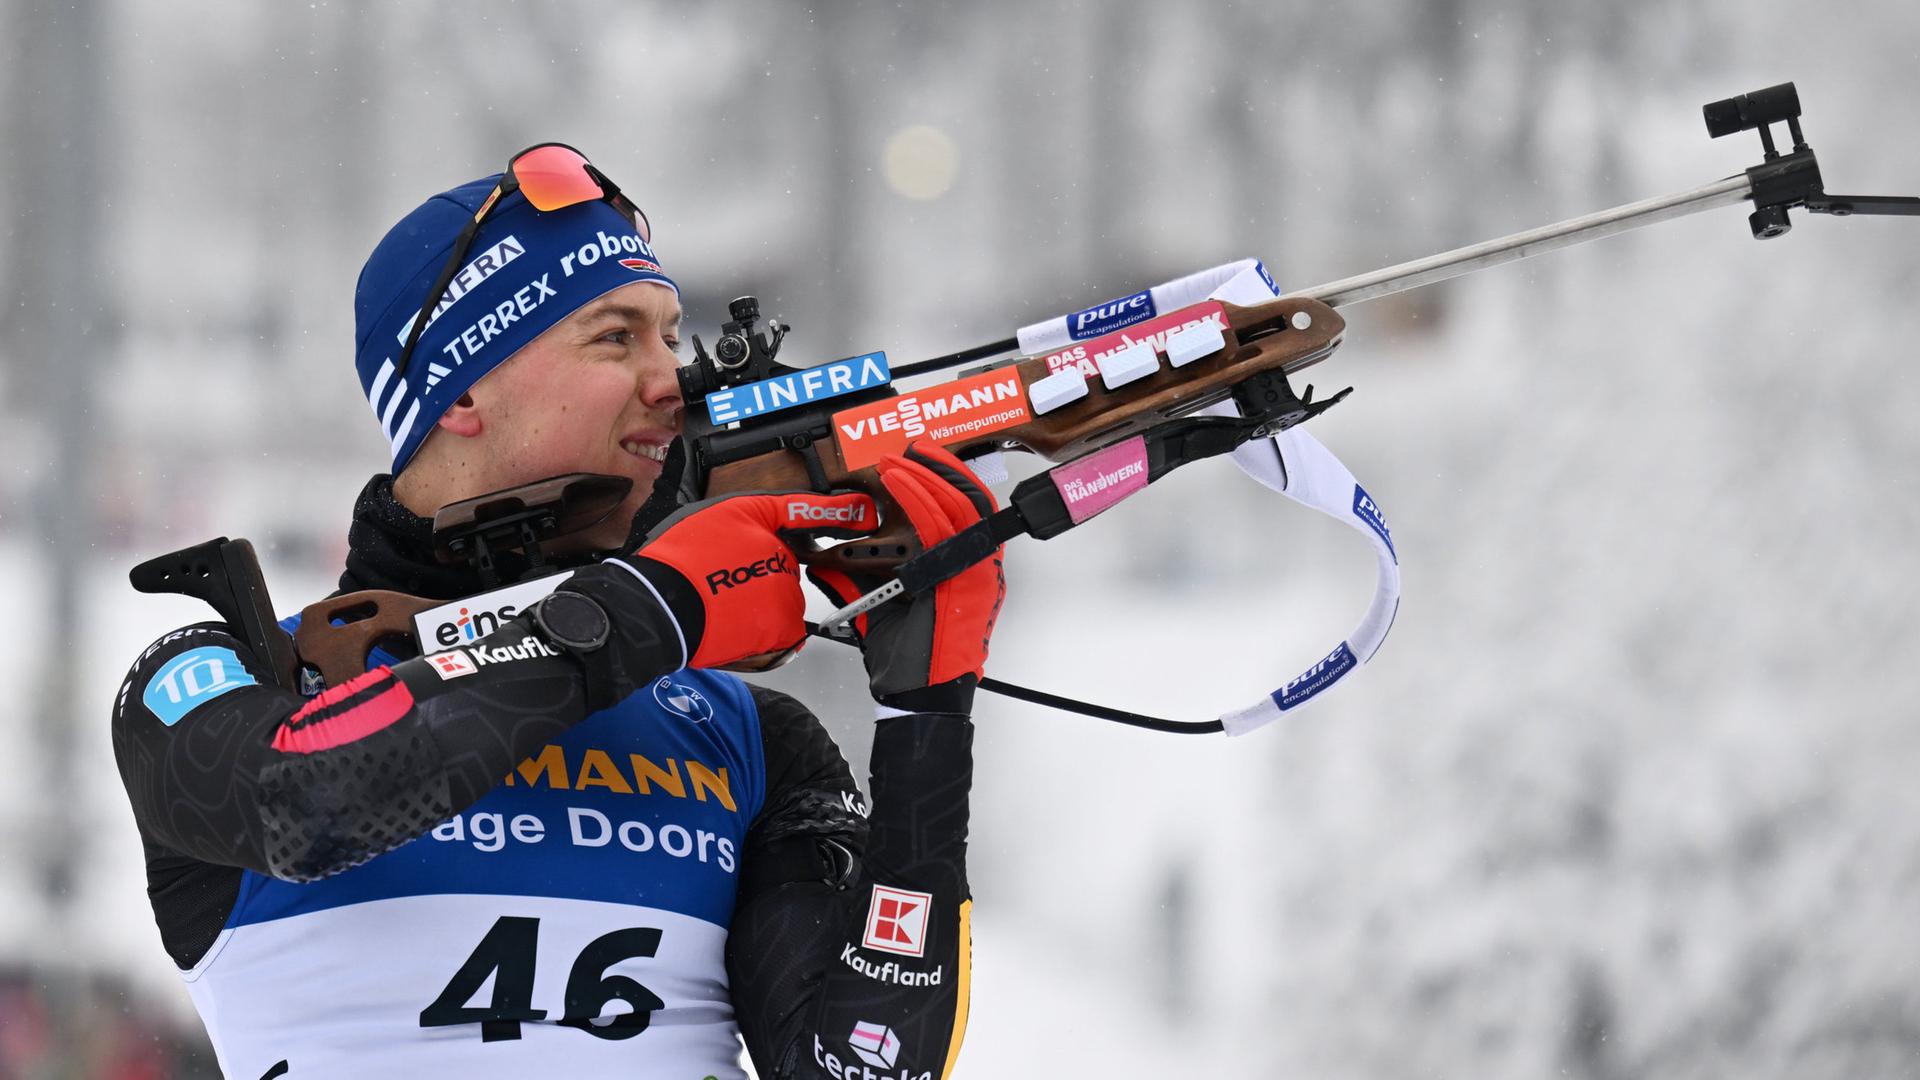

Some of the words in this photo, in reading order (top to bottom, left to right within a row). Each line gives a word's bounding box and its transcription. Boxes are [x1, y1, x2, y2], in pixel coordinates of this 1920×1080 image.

[443, 272, 557, 366] TERREX
[1077, 294, 1147, 330] pure
[1077, 311, 1150, 337] encapsulations
[1047, 346, 1087, 369] DAS
[711, 357, 886, 422] E.INFRA
[841, 379, 1018, 440] VIESSMANN
[929, 407, 1024, 440] Wärmepumpen
[1063, 478, 1083, 492] DAS
[567, 807, 735, 873] Doors
[420, 916, 665, 1042] 46
[840, 942, 942, 986] Kaufland
